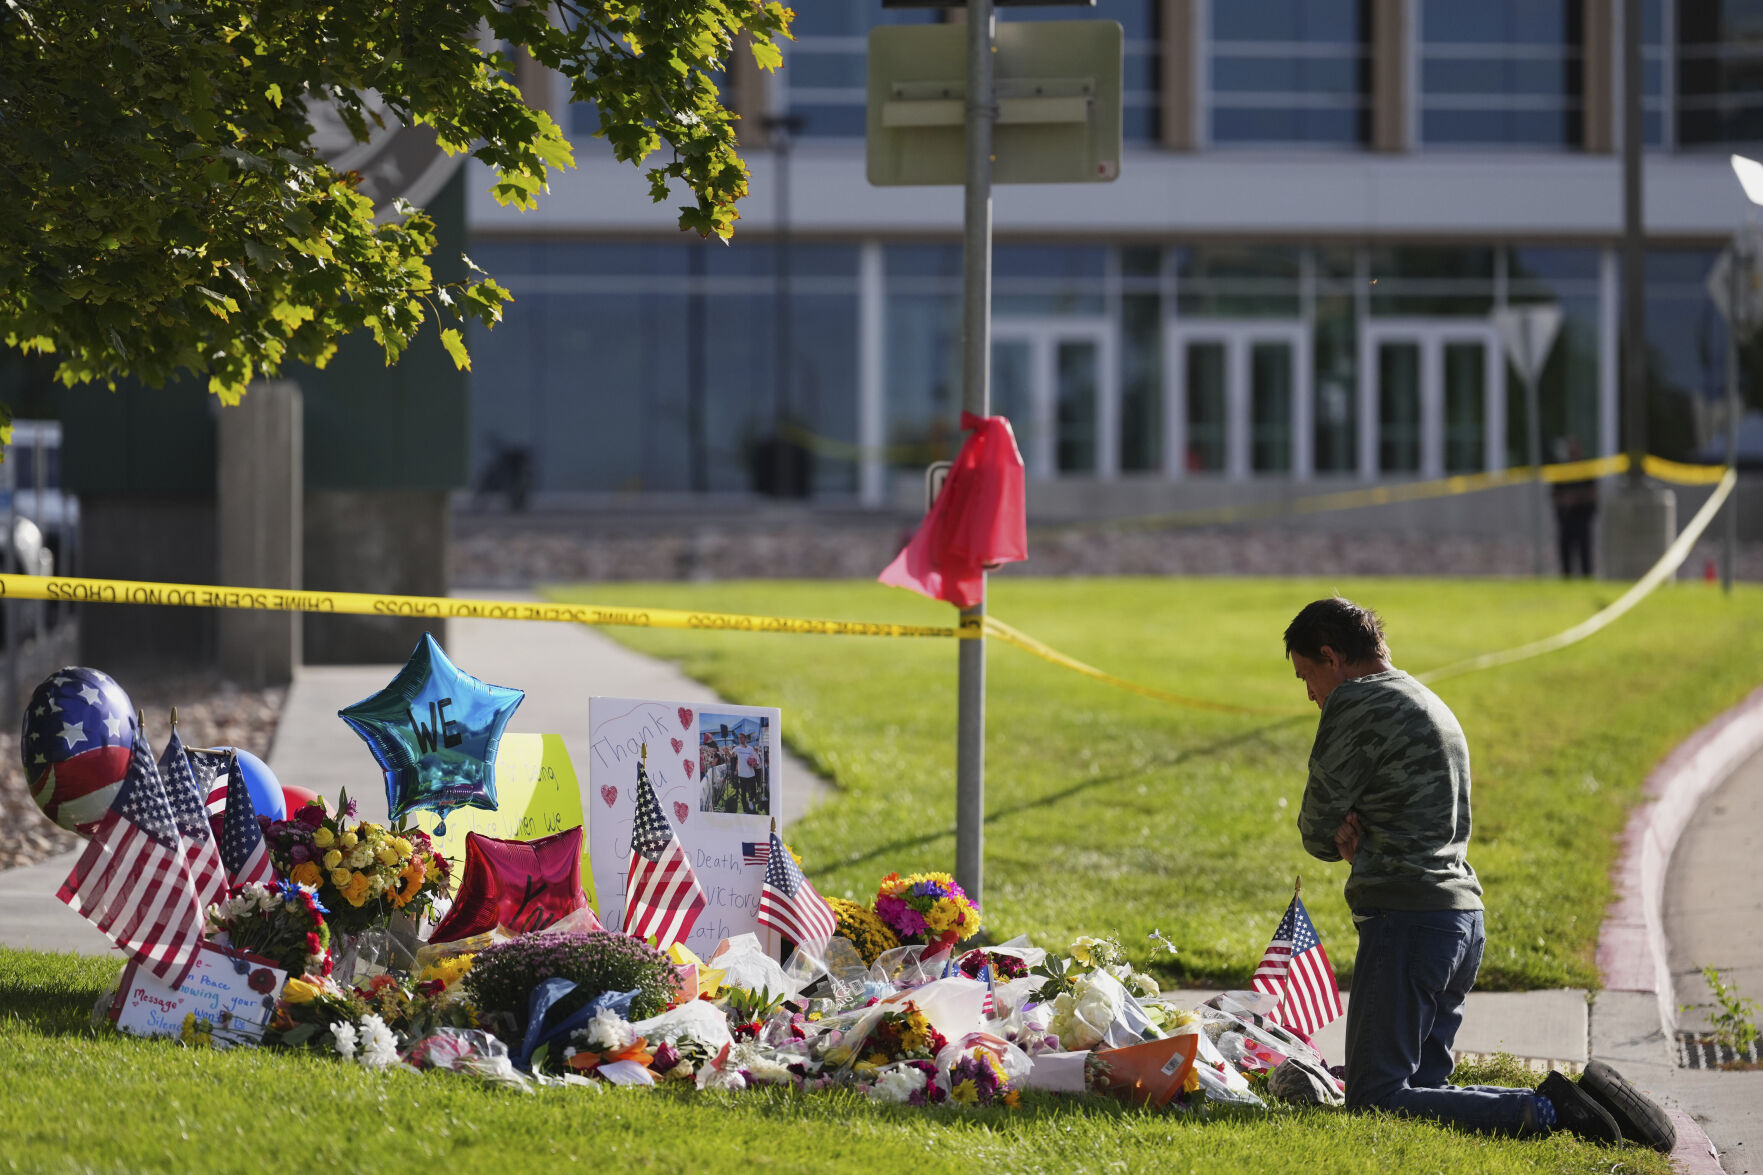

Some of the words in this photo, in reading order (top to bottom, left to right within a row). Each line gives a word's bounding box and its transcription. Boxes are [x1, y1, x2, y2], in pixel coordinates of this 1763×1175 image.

[47, 582, 116, 601] CROSS
[126, 586, 161, 604] NOT
[167, 589, 195, 606] DO
[202, 591, 267, 609] SCENE
[407, 697, 462, 754] WE
[592, 711, 669, 769] Thank
[200, 974, 231, 991] Peace
[133, 988, 177, 1013] Message
